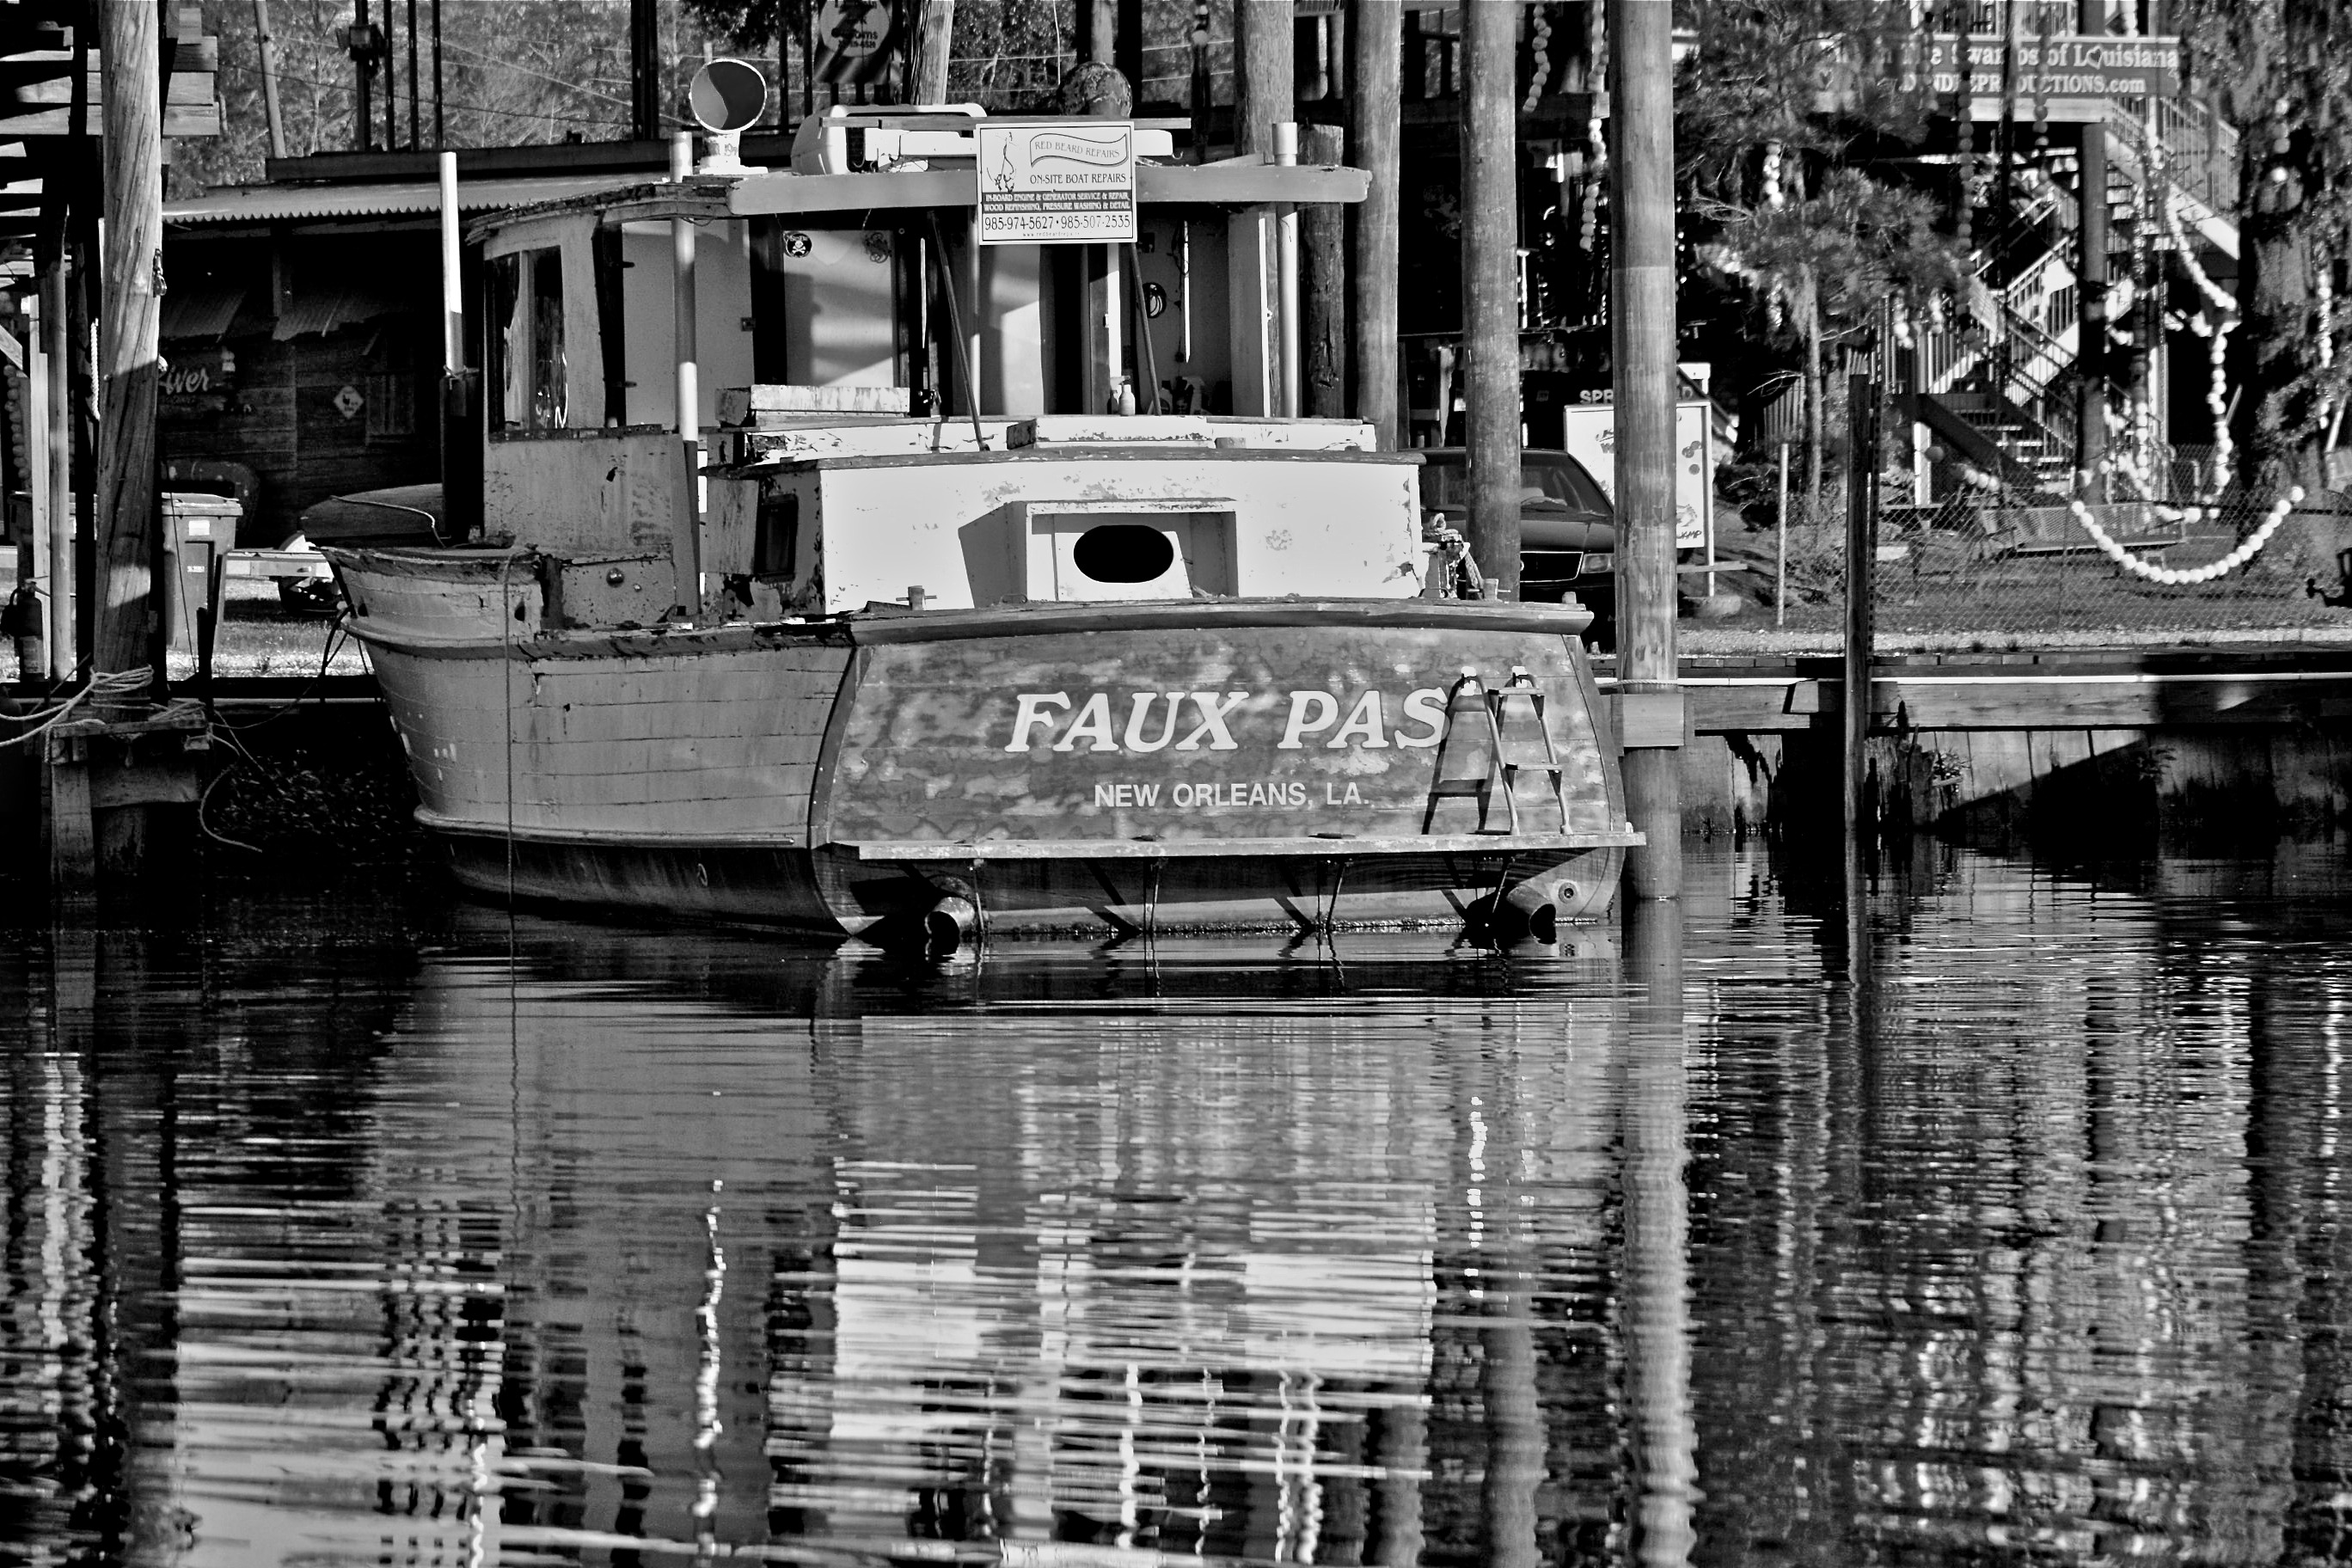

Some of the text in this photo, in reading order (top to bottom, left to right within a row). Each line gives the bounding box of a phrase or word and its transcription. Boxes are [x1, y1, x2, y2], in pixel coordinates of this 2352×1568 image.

[2047, 43, 2070, 67] of
[1035, 141, 1121, 159] RED BEARD REPAIRS
[1030, 173, 1127, 185] ON-SITE BOAT REPAIRS
[983, 203, 1004, 211] WOOD
[1042, 202, 1073, 211] PRESSURE
[1103, 201, 1108, 210] &
[1109, 201, 1131, 210] DETAIL
[985, 193, 1014, 202] IN-BOARD
[1042, 193, 1076, 201] GENERATOR
[1076, 192, 1101, 200] SERVICE
[1102, 192, 1108, 200] &
[984, 214, 1131, 230] 985-974-5627 985-507-2535
[158, 364, 210, 395] iver
[1004, 686, 1452, 753] FAUX PAS
[1094, 781, 1370, 810] NEW ORLEANS, LA.
